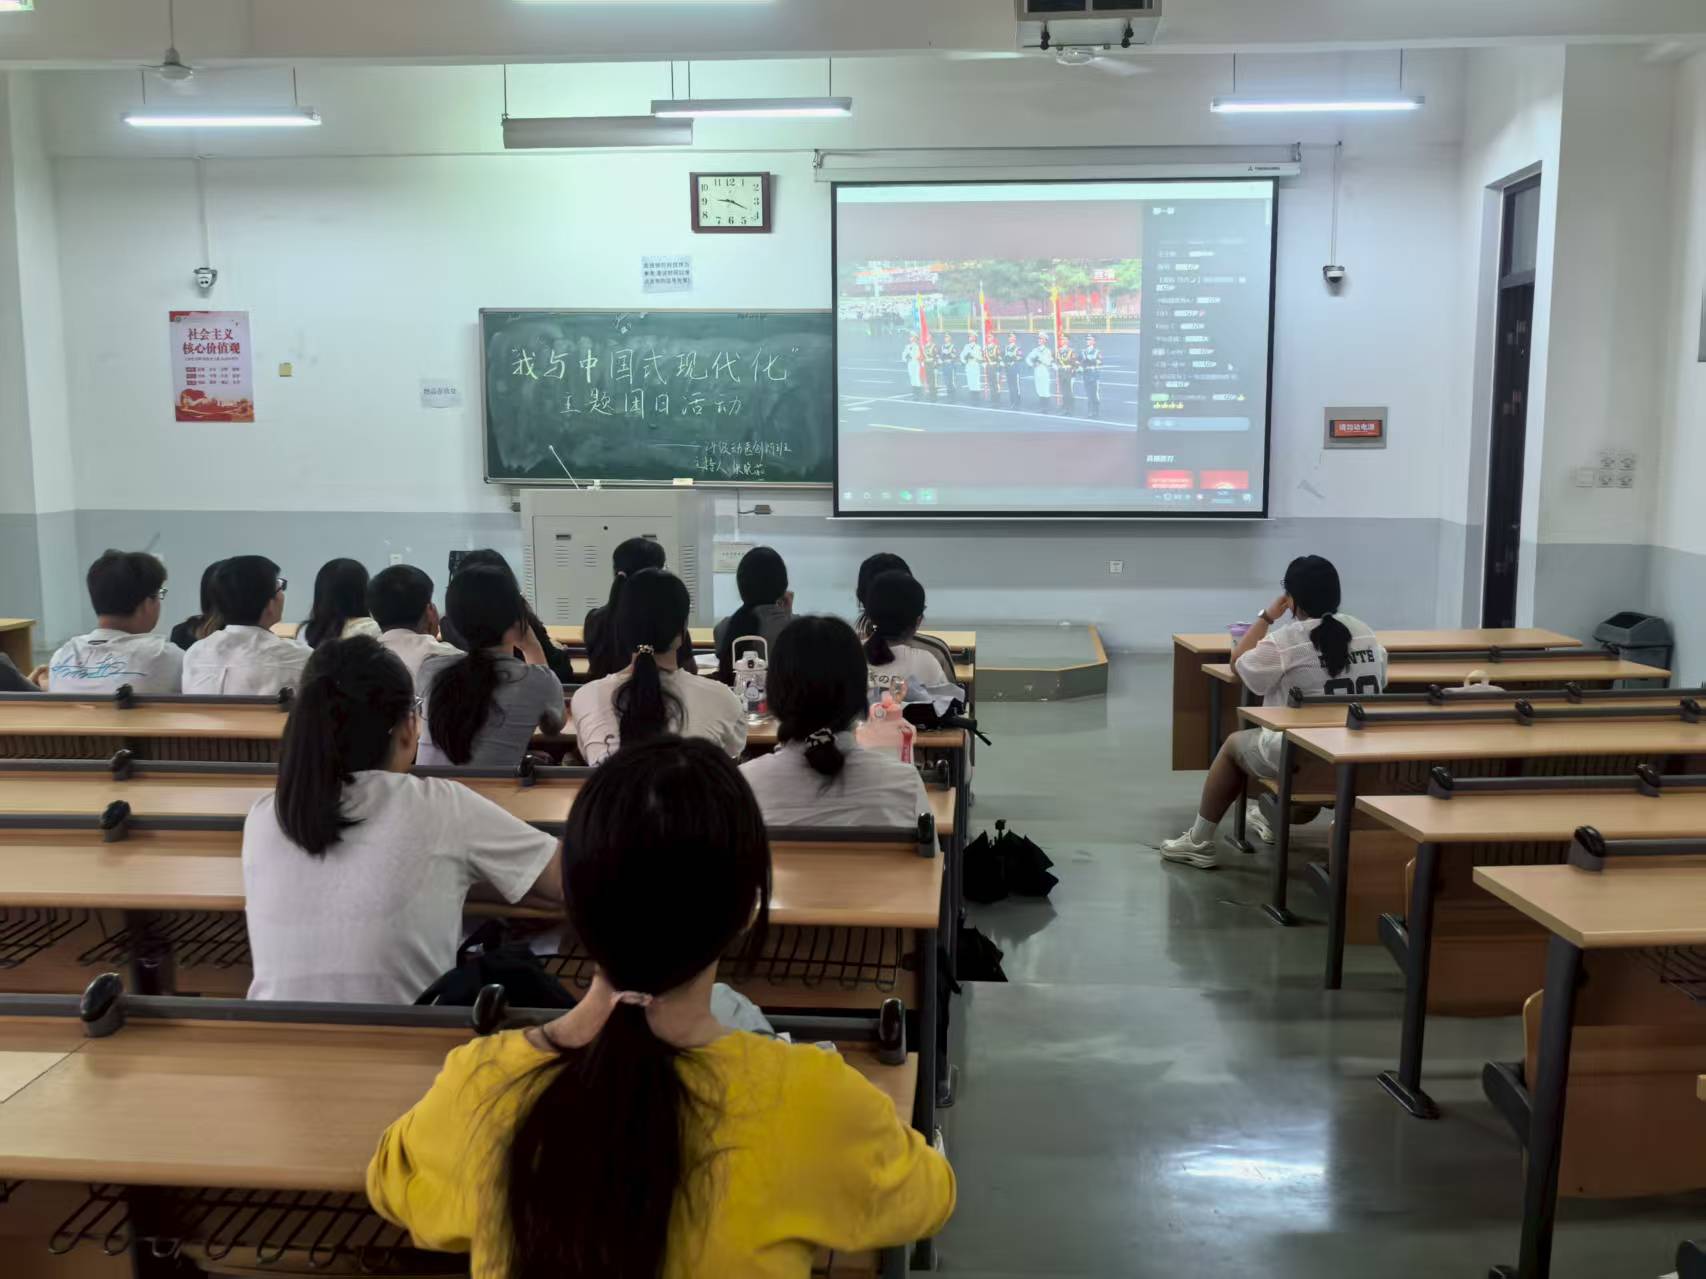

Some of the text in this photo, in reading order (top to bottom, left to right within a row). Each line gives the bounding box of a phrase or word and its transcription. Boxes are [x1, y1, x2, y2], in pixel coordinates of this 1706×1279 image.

[726, 178, 735, 186] 12
[701, 184, 708, 192] 10
[753, 197, 760, 206] 3
[702, 211, 708, 219] 8
[715, 216, 721, 224] 7
[728, 216, 734, 224] 6
[740, 216, 747, 224] 5
[188, 328, 233, 340] 社会主义
[183, 342, 240, 354] 核心价值观
[560, 388, 743, 419] 主题团日活动
